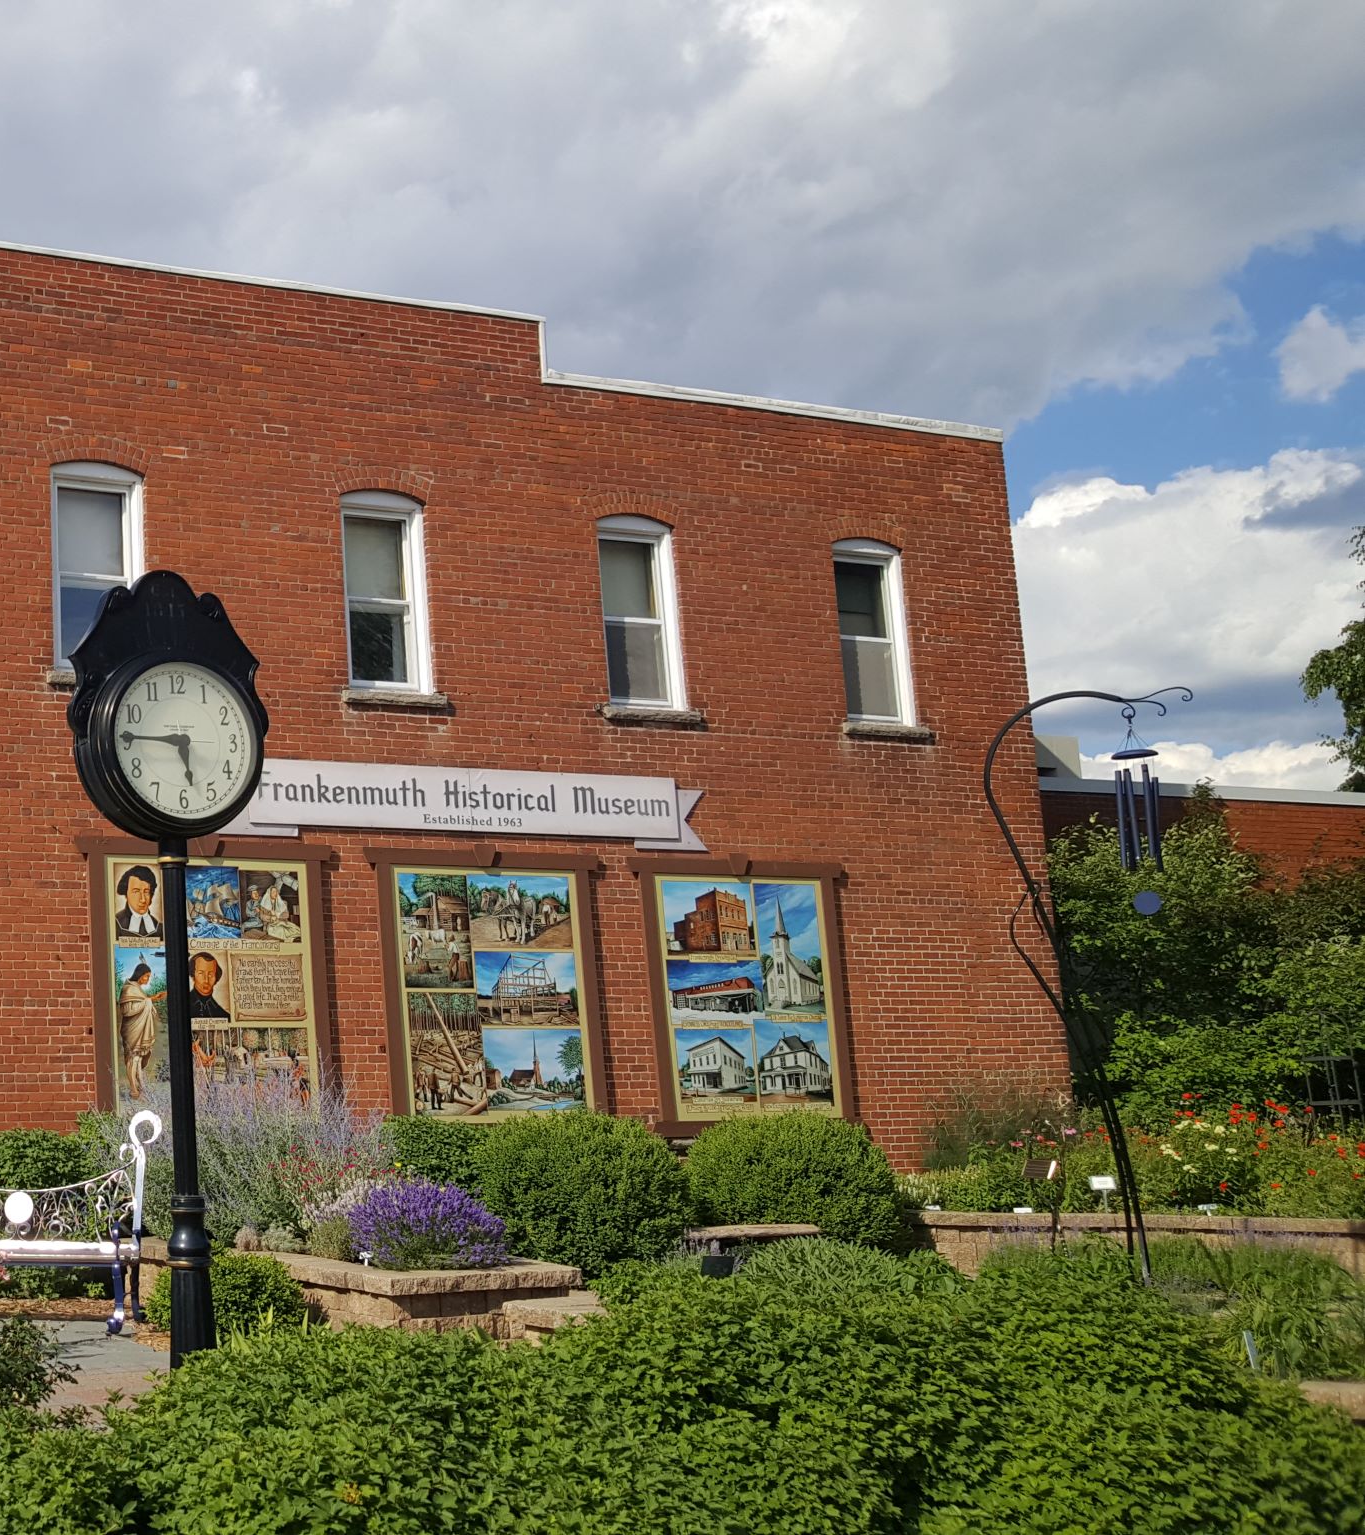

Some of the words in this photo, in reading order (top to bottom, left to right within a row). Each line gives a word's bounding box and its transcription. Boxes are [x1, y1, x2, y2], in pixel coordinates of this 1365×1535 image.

[146, 682, 159, 701] 11
[169, 675, 186, 694] 12
[200, 684, 208, 704] 1
[126, 704, 142, 724] 10
[219, 705, 230, 726] 2
[229, 733, 238, 753] 3
[131, 757, 142, 778] 8
[222, 759, 233, 780] 4
[149, 782, 161, 802] 7
[179, 789, 189, 809] 6
[206, 781, 217, 801] 5
[258, 771, 426, 807] Frankenmuth
[444, 779, 556, 813] Historical
[572, 785, 671, 818] Museum
[423, 813, 493, 827] Established
[497, 817, 523, 828] 1963
[190, 939, 219, 949] Courage
